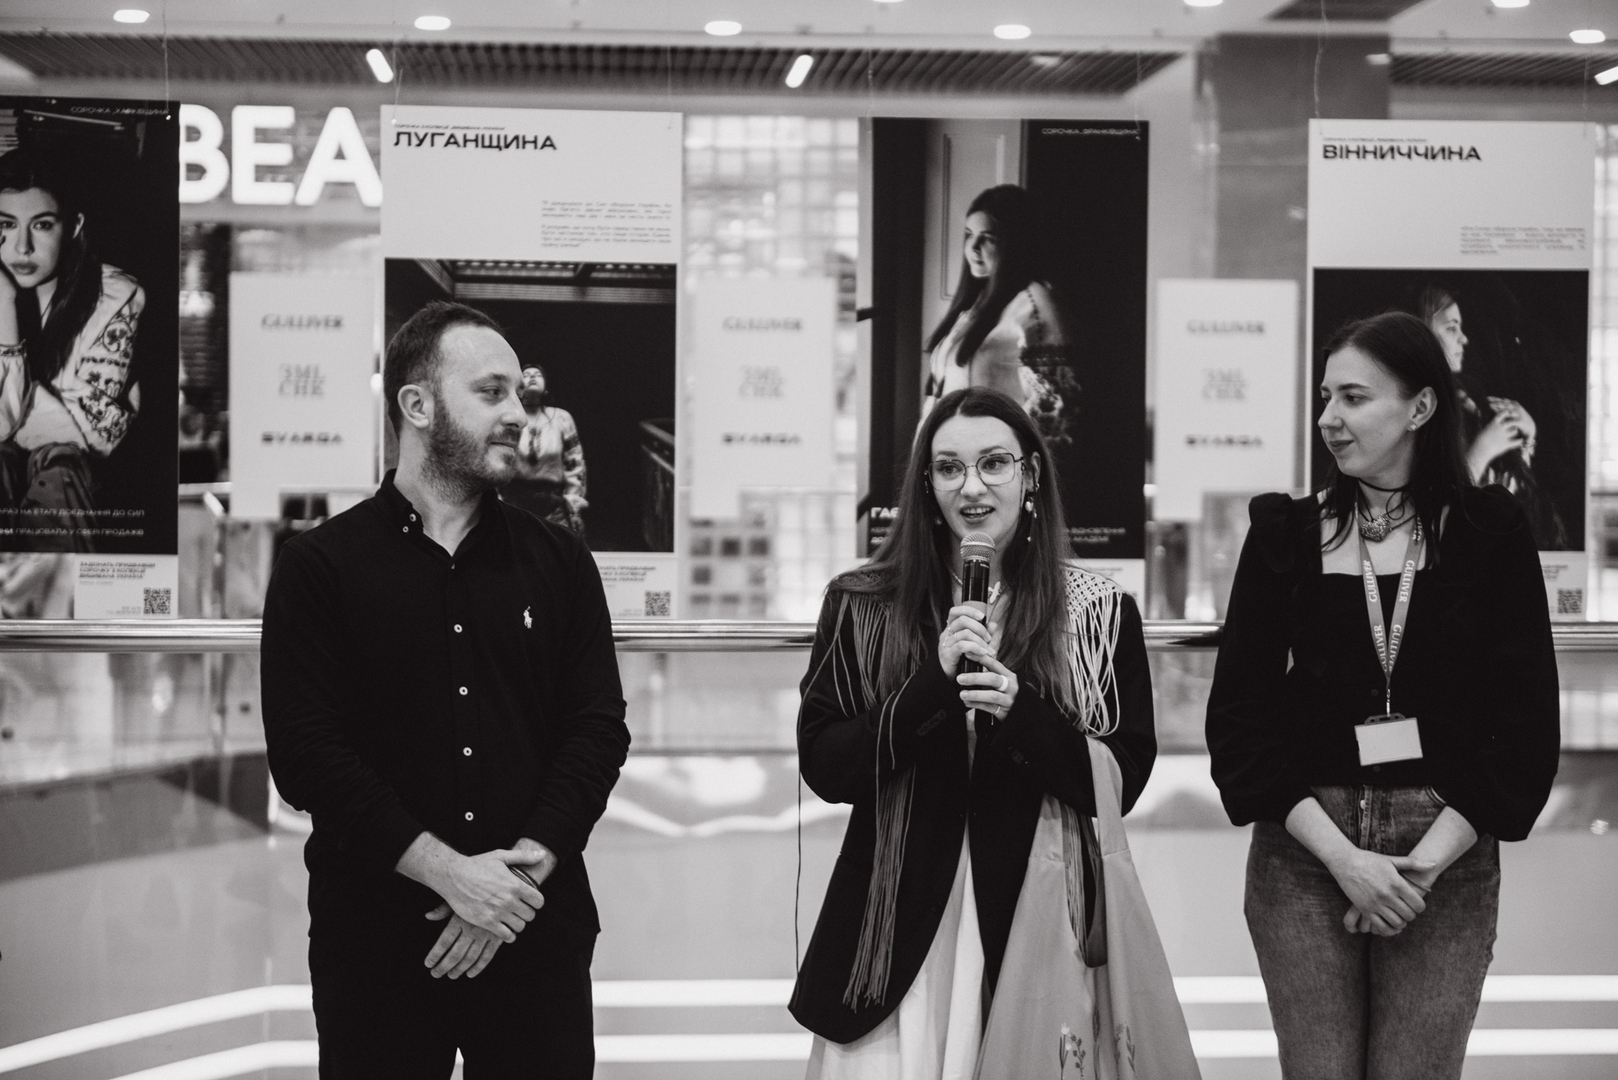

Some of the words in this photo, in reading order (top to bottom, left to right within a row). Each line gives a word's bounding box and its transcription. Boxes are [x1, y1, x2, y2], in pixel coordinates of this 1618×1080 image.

[394, 131, 557, 151] ЛУГАНЩИНА
[1322, 144, 1482, 160] ВІННИЧЧИНА
[1363, 560, 1378, 602] GULLIVER
[1398, 560, 1415, 602] GULLIVER
